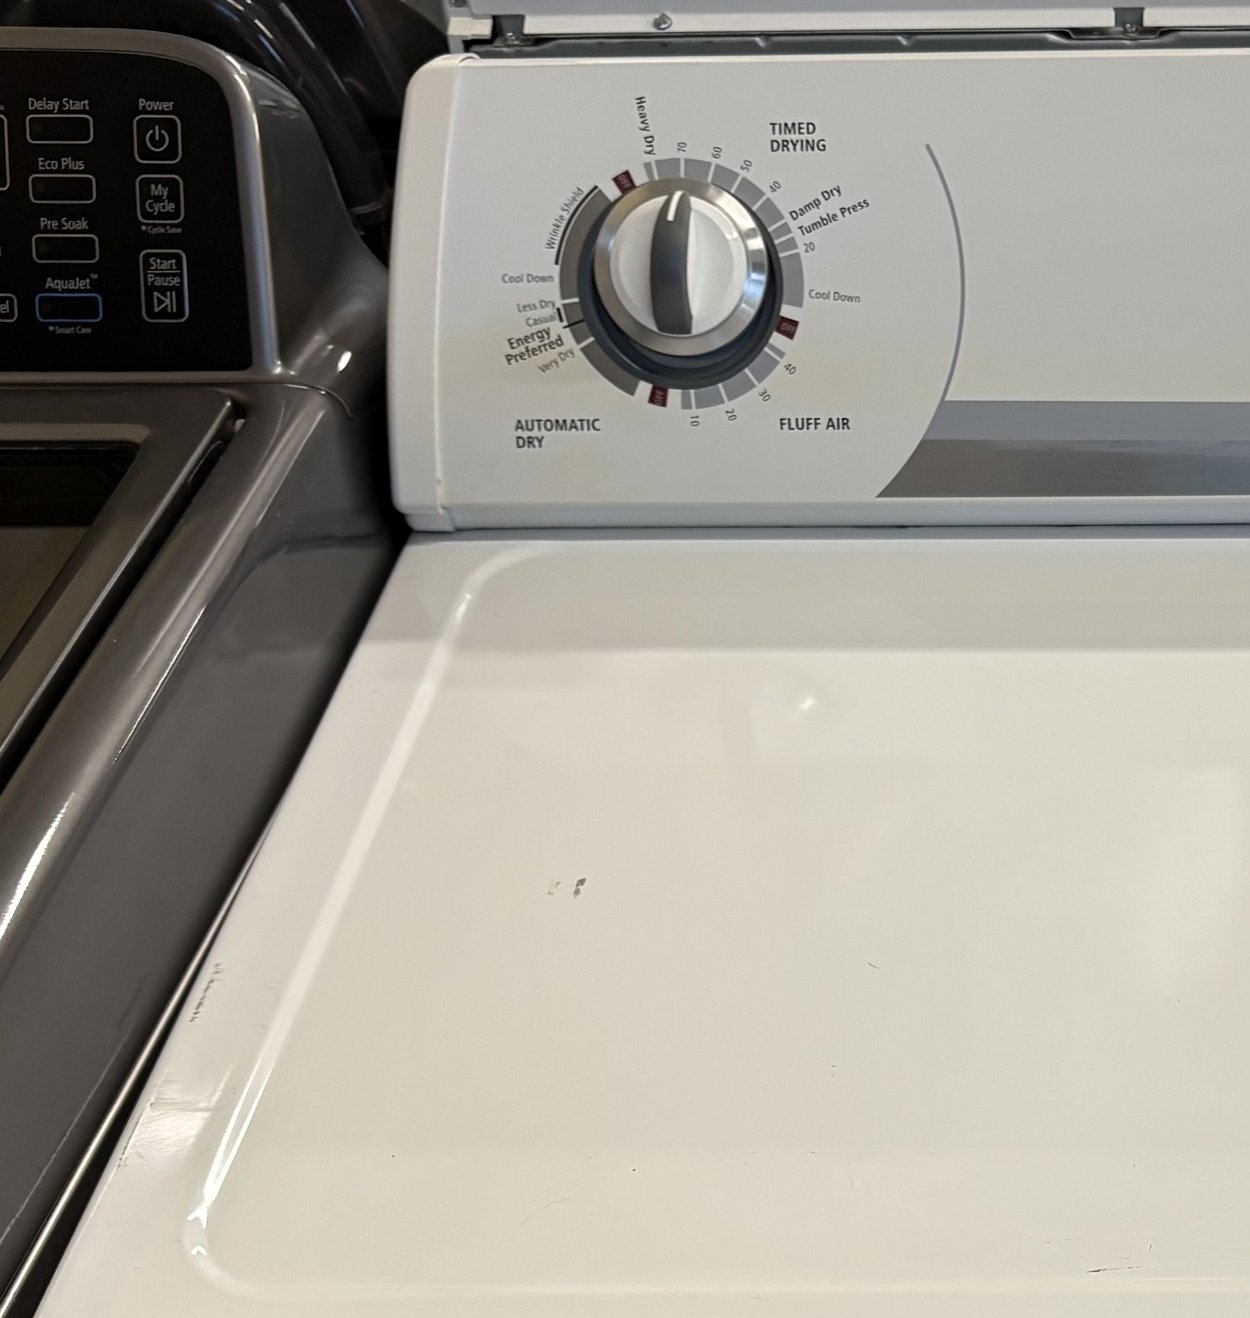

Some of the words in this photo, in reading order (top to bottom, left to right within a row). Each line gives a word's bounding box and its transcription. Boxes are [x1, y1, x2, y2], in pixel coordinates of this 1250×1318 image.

[28, 97, 60, 113] Delay
[62, 98, 90, 110] Start
[138, 99, 175, 111] Power
[635, 96, 650, 132] Heavy
[643, 135, 656, 156] Dry
[769, 122, 816, 135] TIMED
[677, 142, 687, 153] 70
[770, 138, 827, 152] DRYING
[711, 146, 723, 159] 60
[38, 157, 58, 170] Eco
[61, 156, 85, 170] Plus
[740, 160, 753, 173] 50
[150, 184, 169, 199] My
[769, 180, 781, 193] 40
[145, 200, 176, 215] Cycle
[788, 198, 822, 221] Damp
[820, 185, 842, 202] Dry
[40, 217, 59, 230] Pre
[61, 216, 89, 230] Soak
[545, 215, 567, 250] Wrinkle
[562, 186, 584, 214] Shield
[797, 213, 839, 236] Tumble
[839, 199, 870, 218] Press
[803, 242, 816, 253] 20
[149, 257, 177, 270] Start
[147, 274, 181, 286] Pause
[502, 273, 525, 284] Cool
[526, 273, 555, 284] Down
[808, 289, 831, 300] Cool
[833, 291, 861, 303] Down
[516, 302, 538, 313] Less
[539, 300, 556, 310] Dry
[507, 327, 551, 350] Energy
[505, 335, 564, 365] Preferred
[784, 363, 797, 375] 40
[758, 389, 771, 402] 30
[690, 415, 700, 427] 10
[725, 408, 737, 422] 20
[515, 419, 601, 432] AUTOMATIC
[779, 417, 821, 430] FLUFF
[825, 417, 851, 430] AIR
[516, 436, 544, 448] DRY
